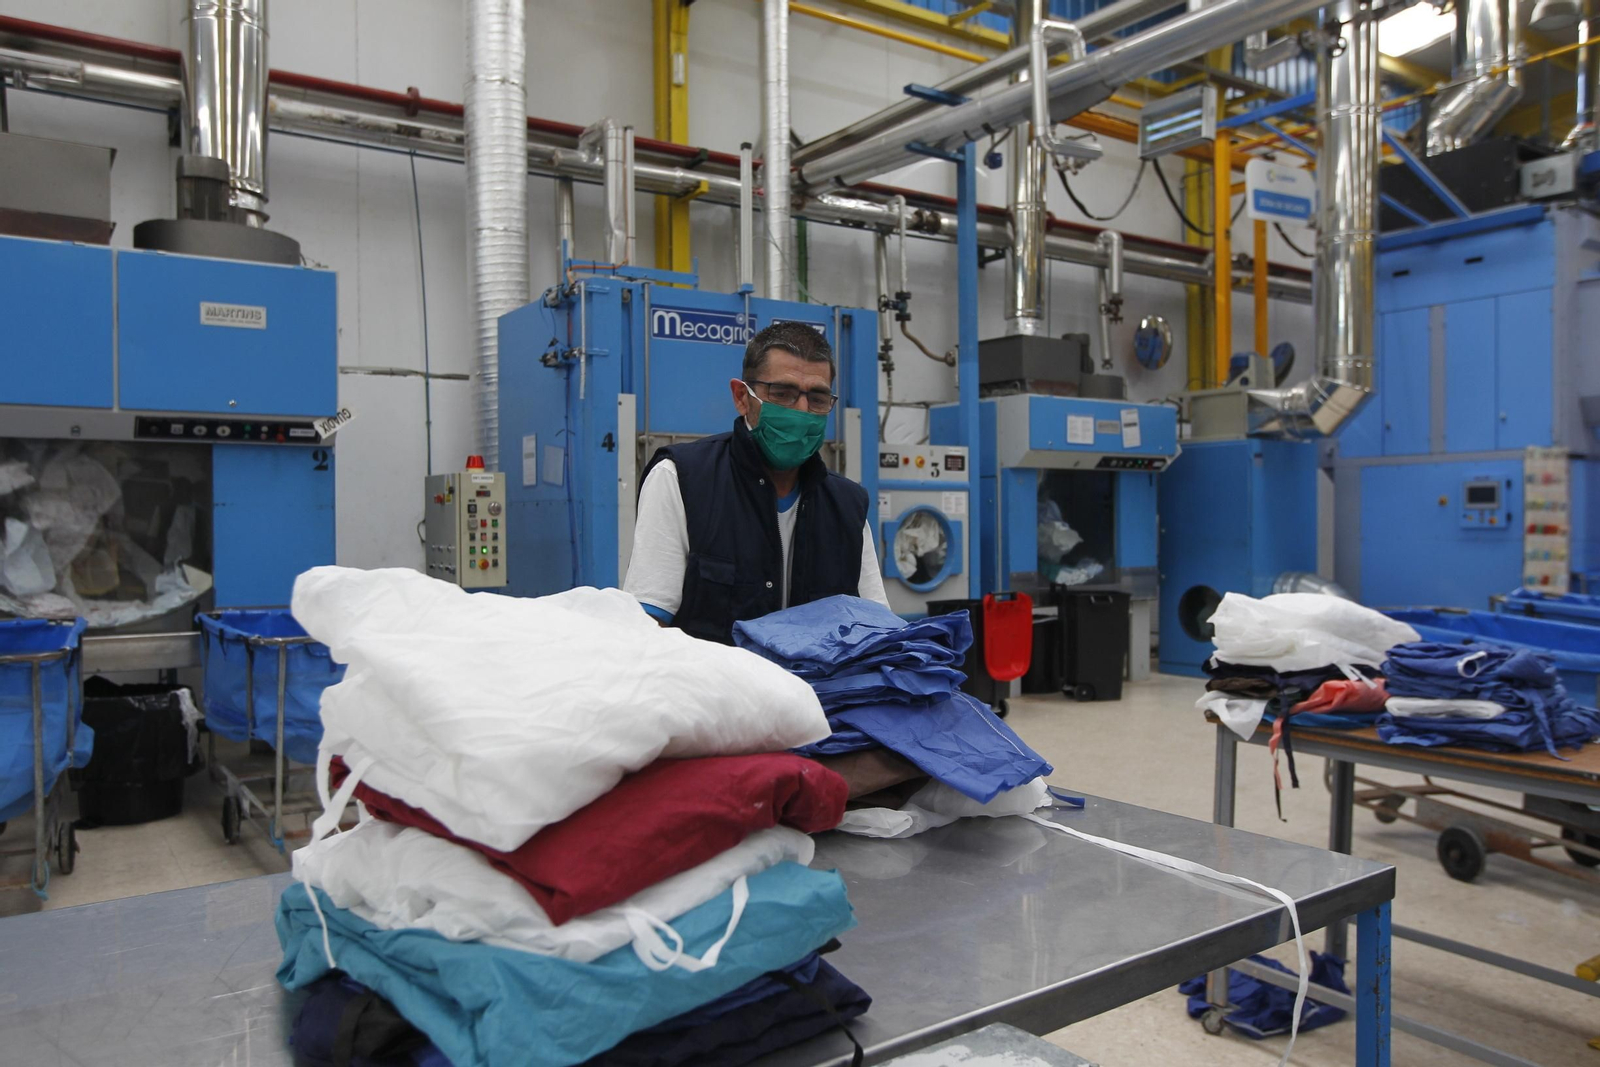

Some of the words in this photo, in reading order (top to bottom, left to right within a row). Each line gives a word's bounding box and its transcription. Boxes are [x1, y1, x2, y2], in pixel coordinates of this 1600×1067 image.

[205, 306, 262, 320] MARTINS
[319, 408, 352, 434] GUADIX
[601, 432, 616, 452] 4
[313, 449, 329, 471] 2
[931, 462, 940, 478] 3
